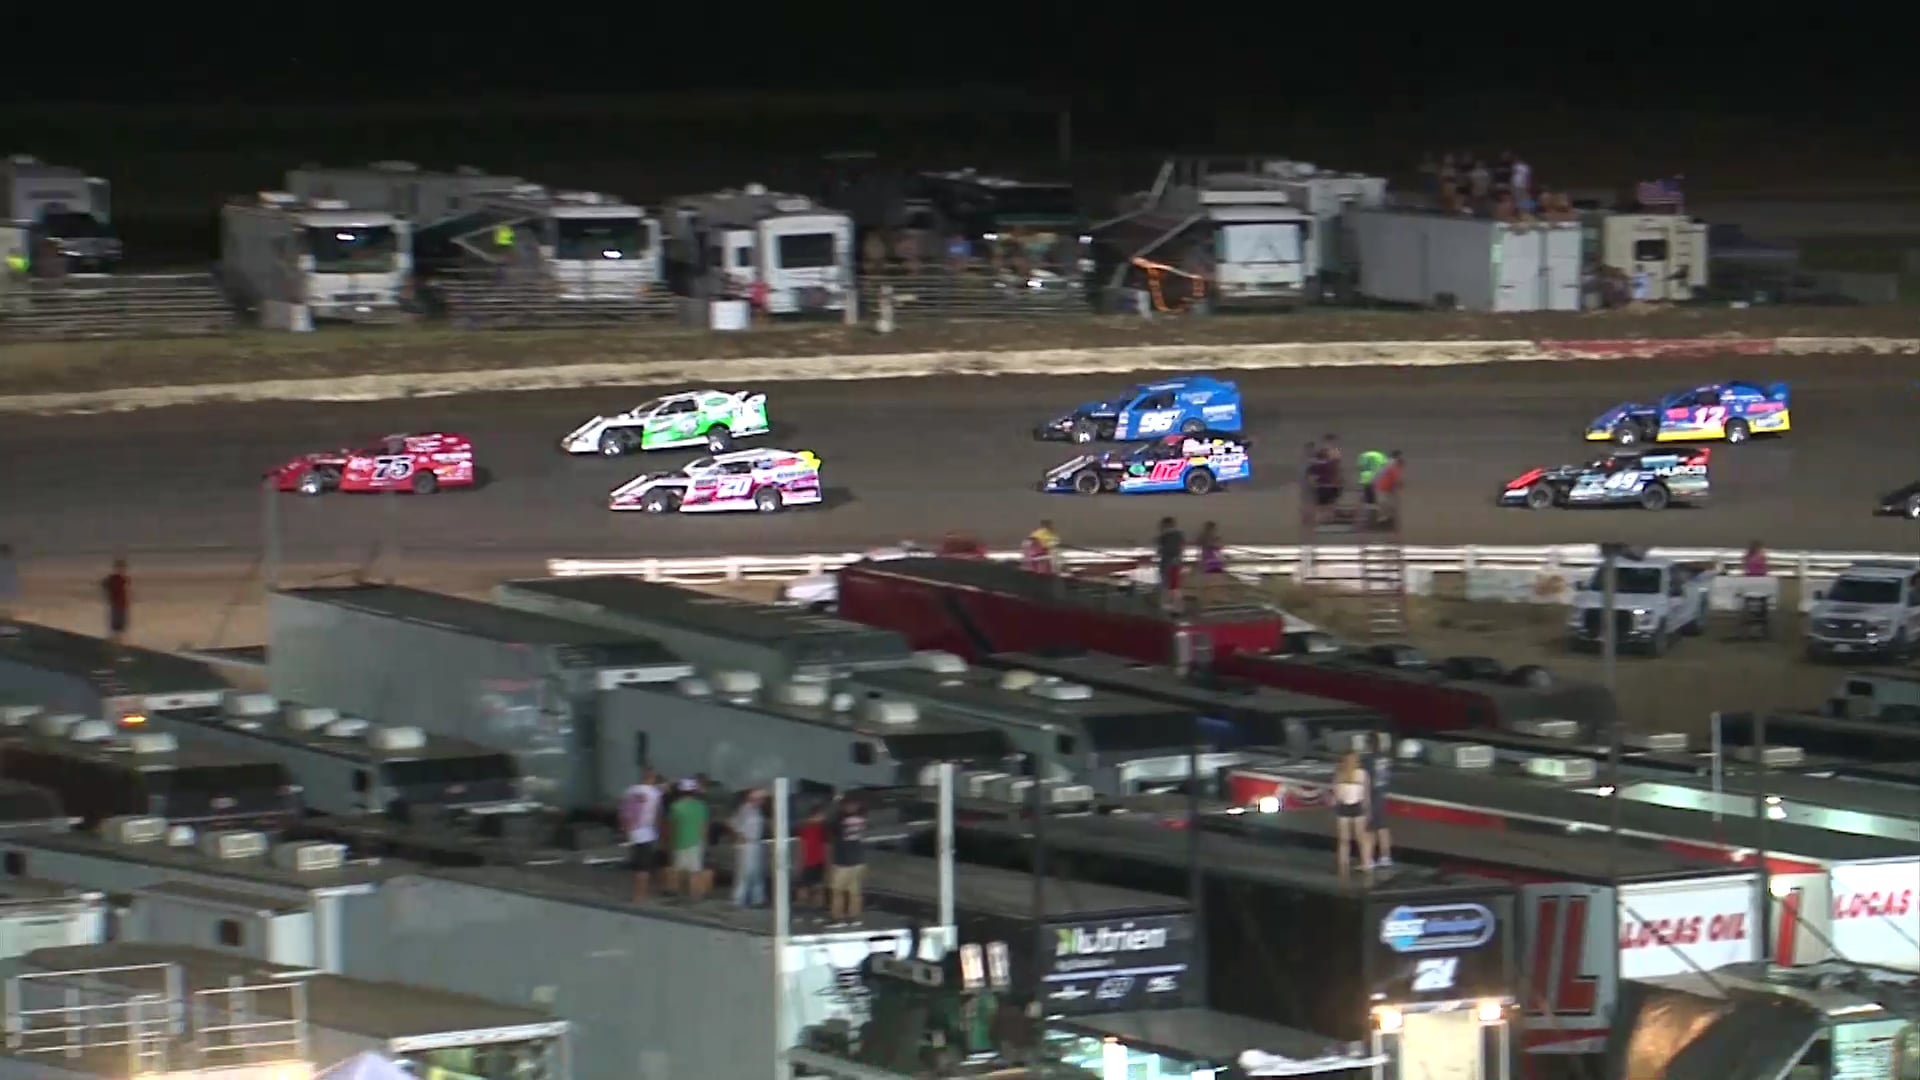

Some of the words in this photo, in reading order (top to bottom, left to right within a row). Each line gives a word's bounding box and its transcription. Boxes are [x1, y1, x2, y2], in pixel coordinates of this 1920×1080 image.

[371, 454, 416, 480] 75
[717, 476, 753, 498] 20
[1831, 889, 1911, 920] LUCAS
[1055, 922, 1168, 956] Nutrien
[1619, 916, 1702, 949] LUCAS
[1709, 912, 1746, 941] OIL
